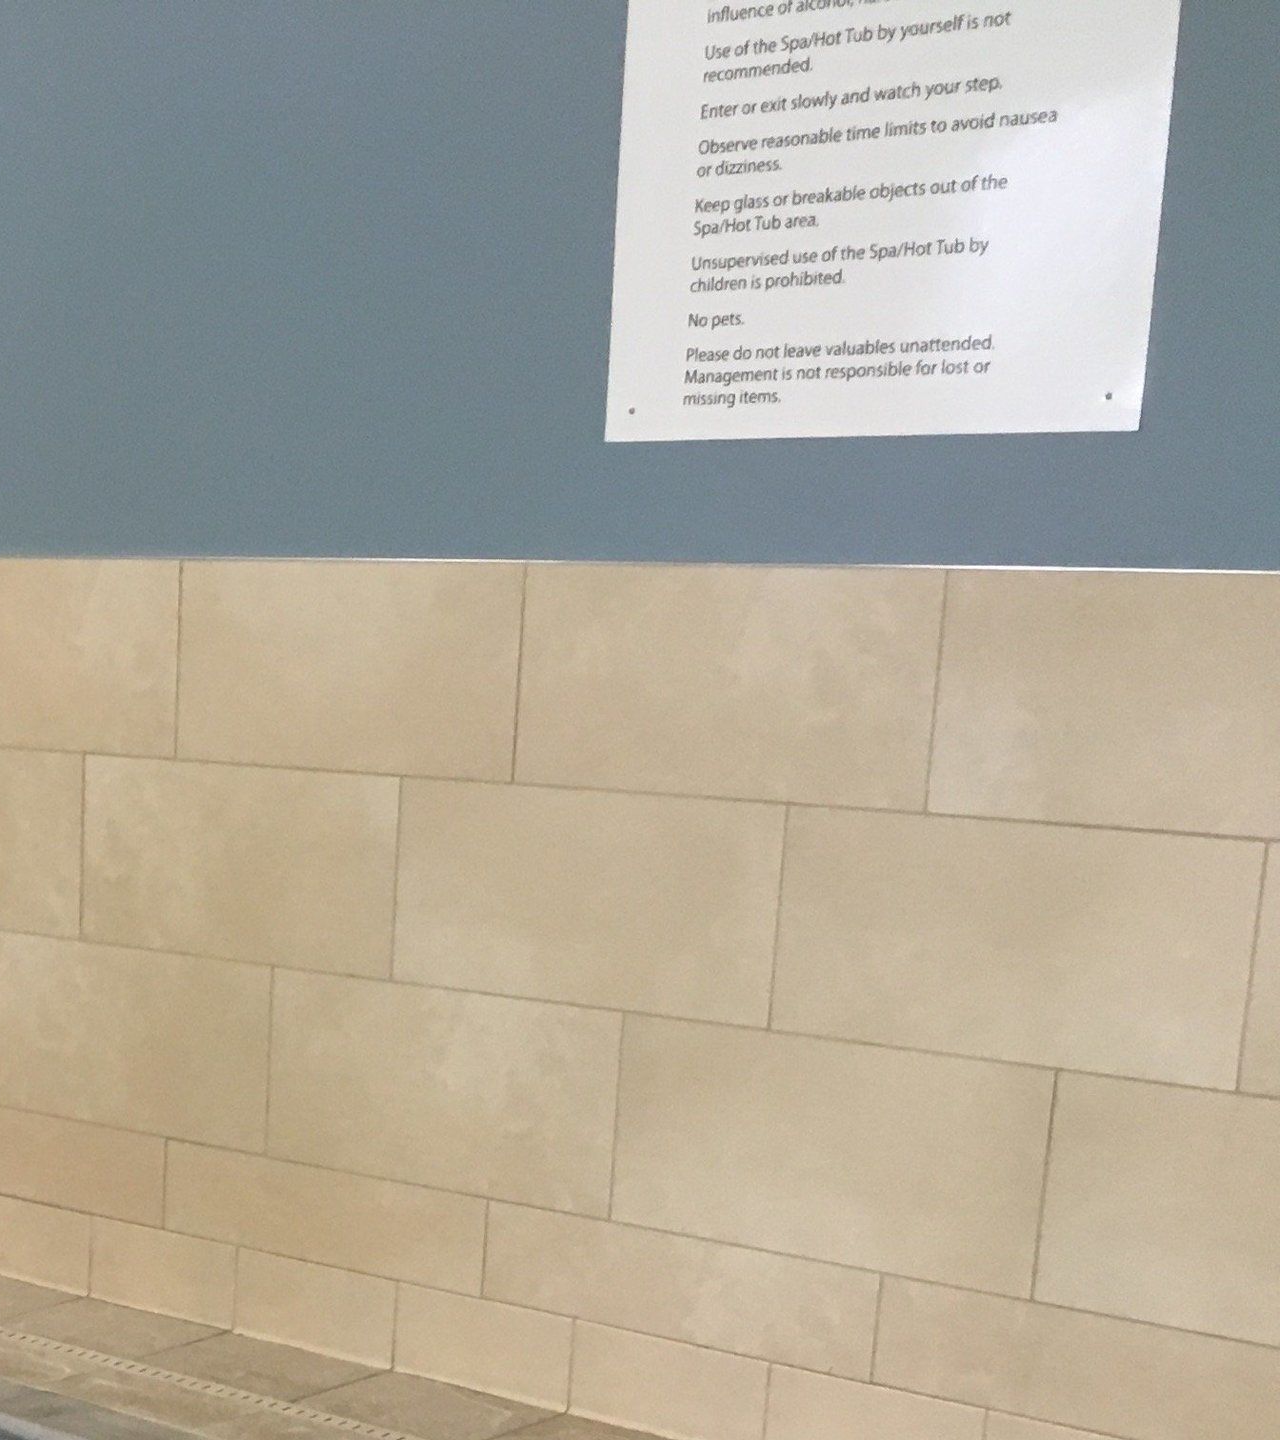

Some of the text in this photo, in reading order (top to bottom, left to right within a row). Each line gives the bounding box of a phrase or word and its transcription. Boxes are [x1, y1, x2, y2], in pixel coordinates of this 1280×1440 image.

[707, 4, 774, 23] influence
[778, 0, 793, 15] of
[705, 11, 1012, 60] Use of the Spa/Hot Tub by yourself is not
[703, 57, 813, 83] recommended.
[700, 76, 1003, 120] Enter or exit slowly and watch your step.
[698, 109, 1058, 155] Observe reasonable time limits to avoid nausea
[696, 157, 782, 178] or dizziness.
[694, 174, 1008, 215] Keep glass or breakable objects out of the
[693, 213, 820, 238] Spa/Hot Tub area.
[691, 236, 989, 272] Unsupervised use of the Spa/Hot Tub by
[690, 269, 845, 293] children is prohibited.
[688, 313, 745, 331] No pets.
[686, 334, 995, 362] Please do not leave valuables unattended.
[684, 359, 990, 386] Management is not responsible for lost or
[683, 390, 781, 409] missing items.
